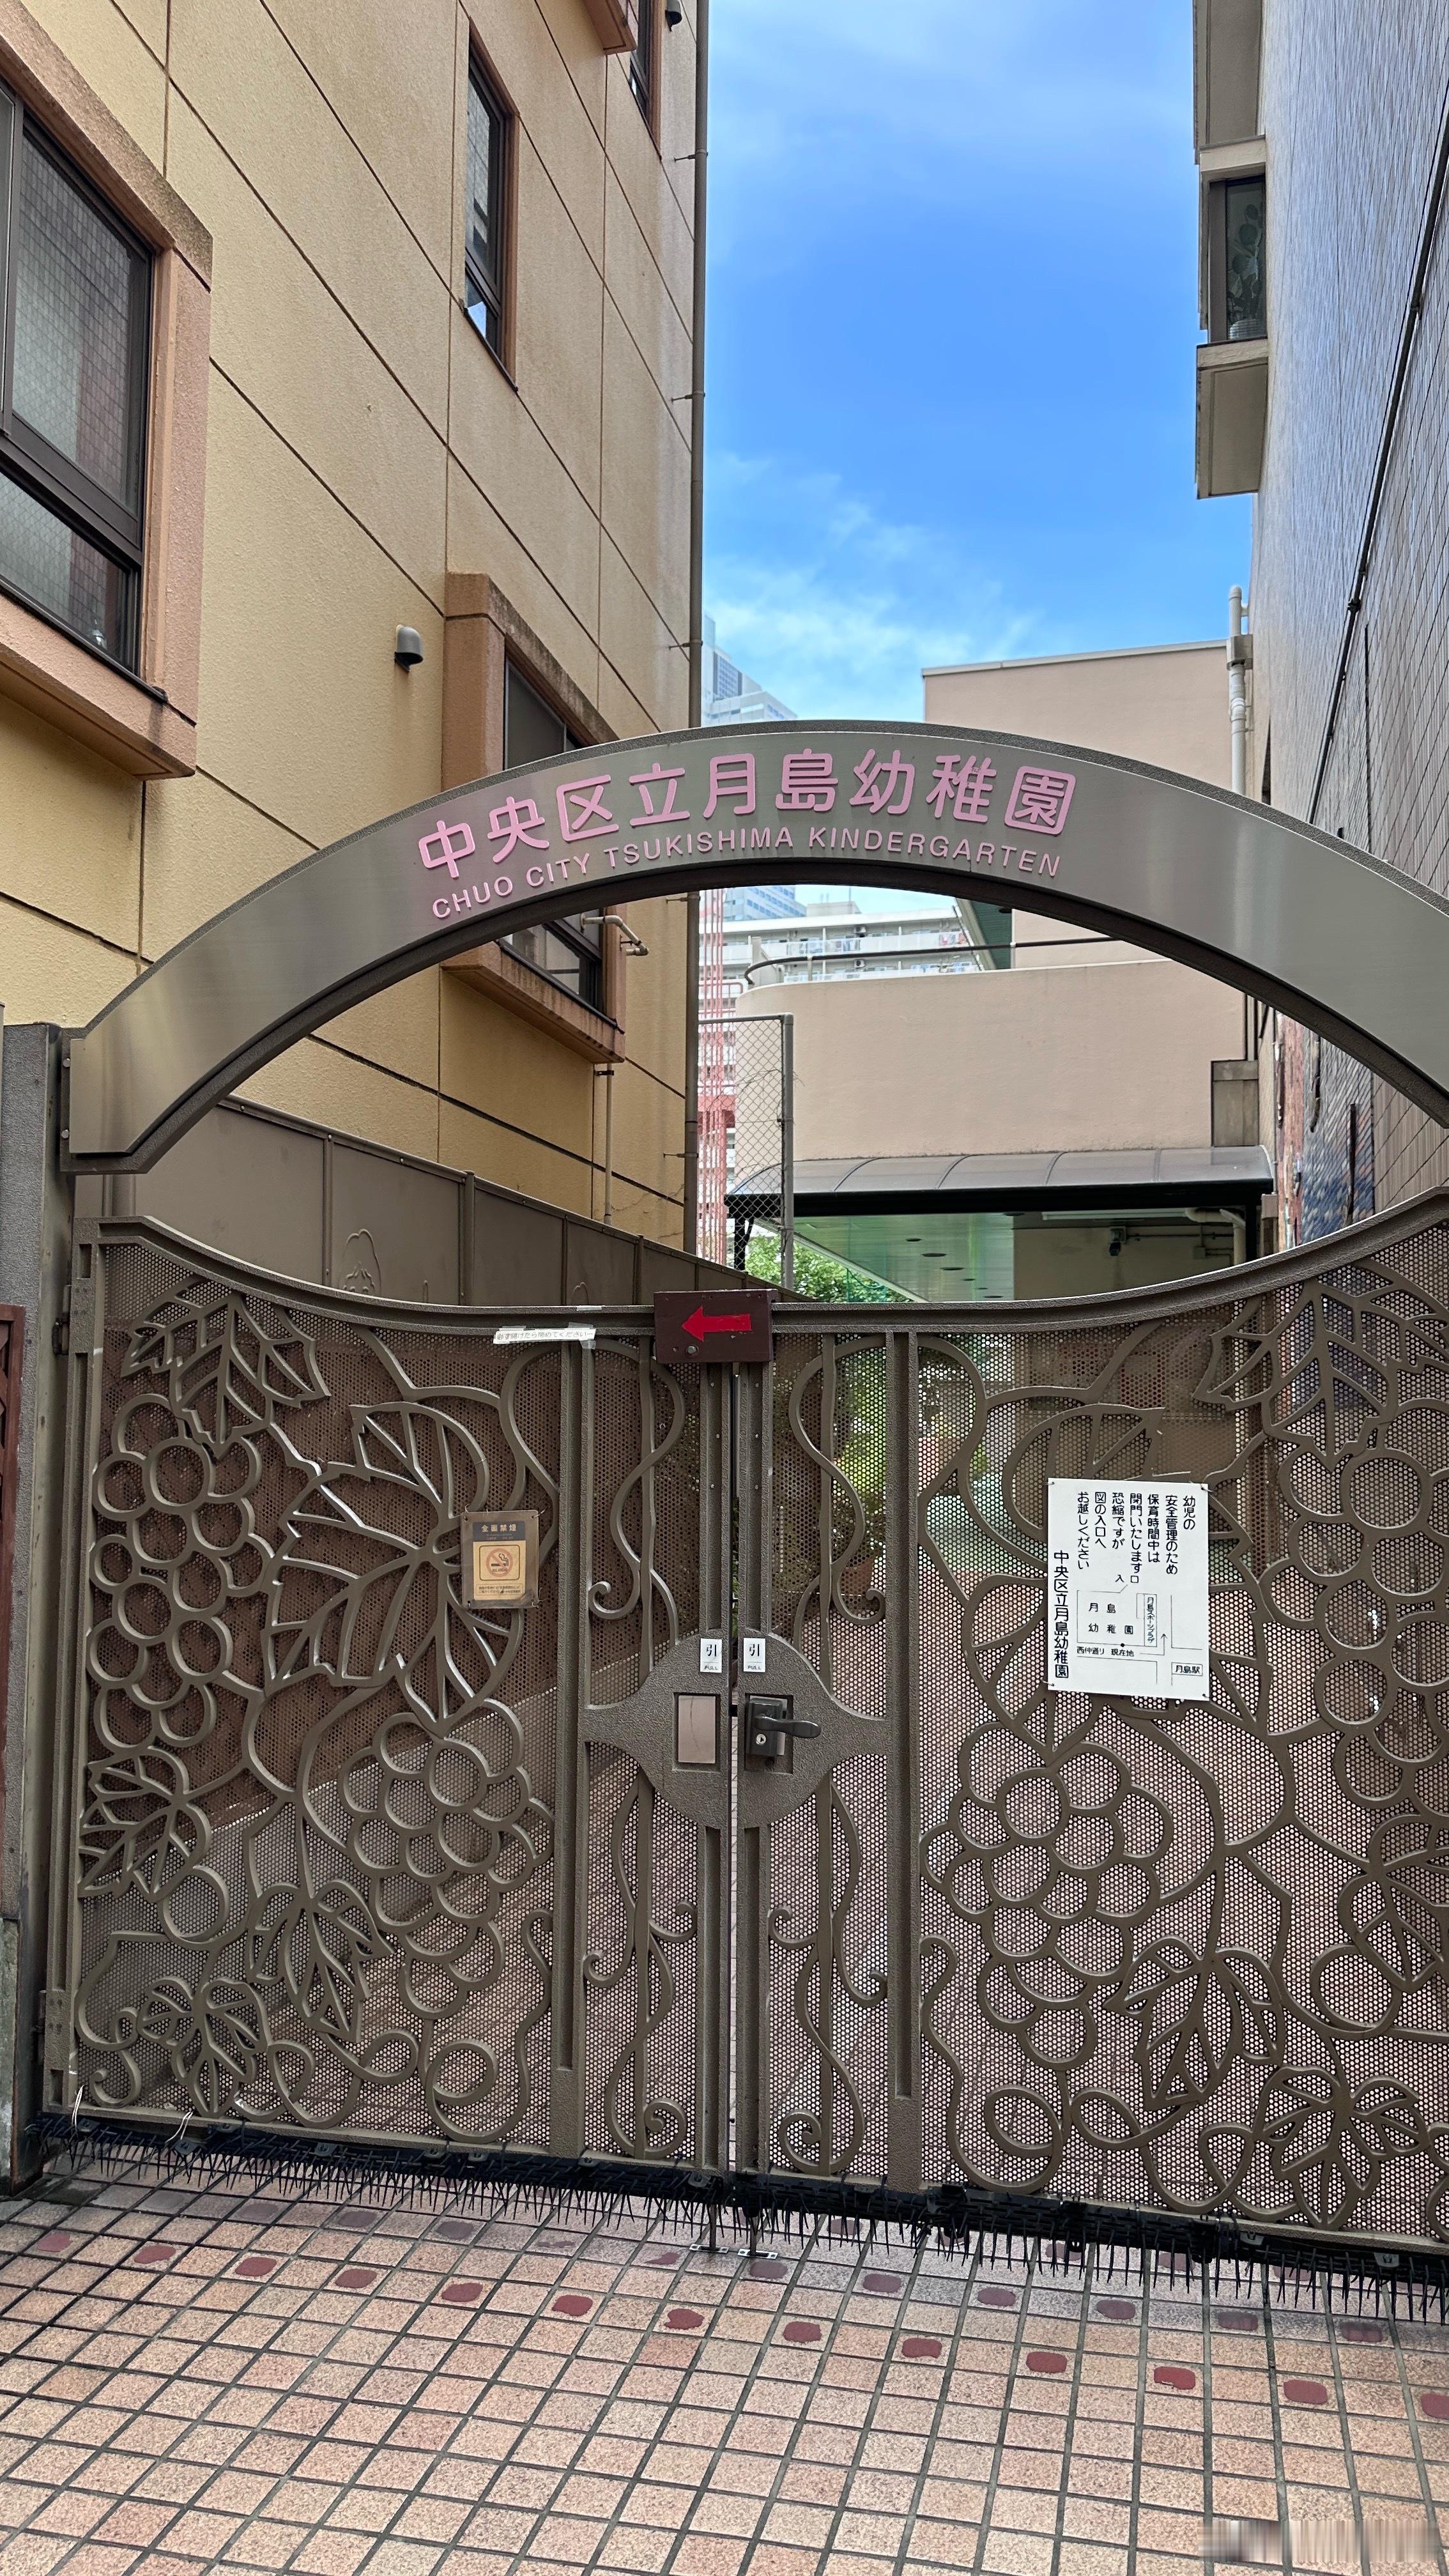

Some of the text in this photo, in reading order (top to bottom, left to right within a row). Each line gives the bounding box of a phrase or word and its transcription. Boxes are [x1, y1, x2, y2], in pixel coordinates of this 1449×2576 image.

[418, 748, 1077, 879] 中央区立月島幼稚園
[432, 827, 1061, 919] CHUO CITY TSUKISHIMA KINDERGARTEN
[1077, 1491, 1090, 1570] お越しください
[1094, 1491, 1107, 1549] 図の入口へ
[1112, 1492, 1125, 1549] 恐縮ですが
[1130, 1492, 1142, 1574] 閉門いたします
[1147, 1494, 1160, 1563] 保育時間中は
[1165, 1494, 1178, 1575] 安全管理のため
[1183, 1495, 1195, 1530] 幼児の
[1054, 1549, 1070, 1679] 中央区立月島幼稚園
[706, 1644, 717, 1657] 引
[749, 1643, 760, 1657] 引
[1077, 1646, 1135, 1657] 西仲通り 現在地
[1175, 1665, 1200, 1674] 月島駅
